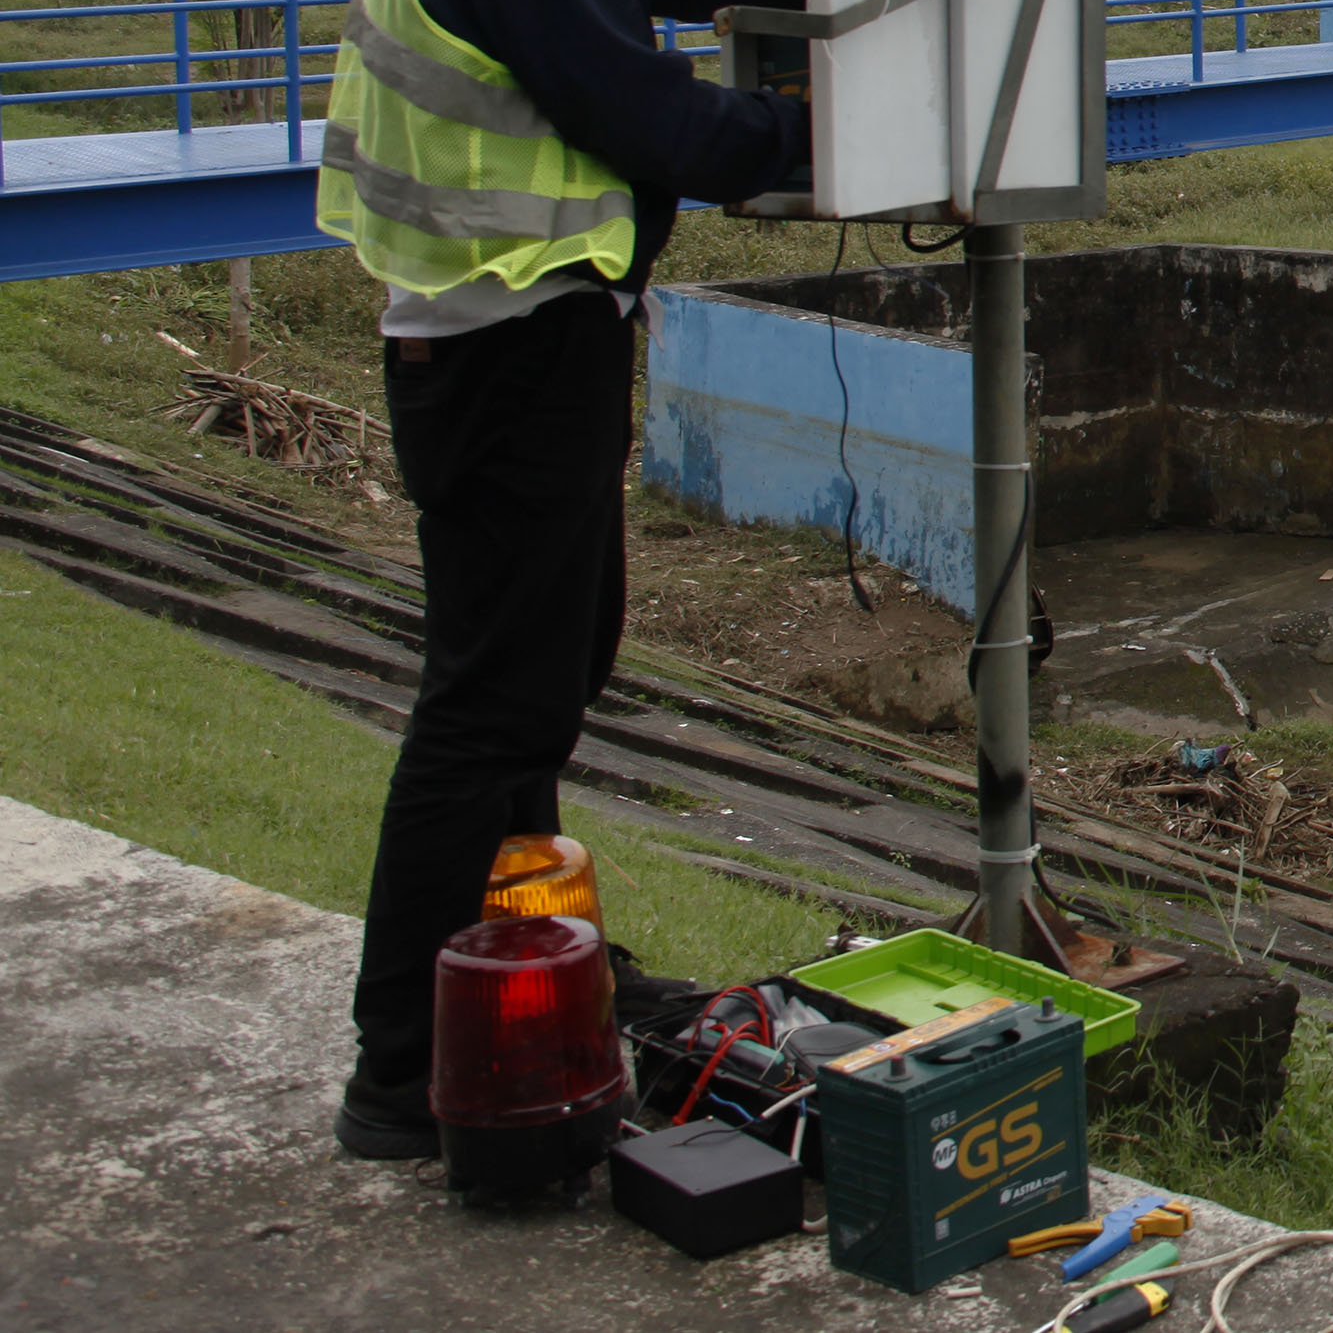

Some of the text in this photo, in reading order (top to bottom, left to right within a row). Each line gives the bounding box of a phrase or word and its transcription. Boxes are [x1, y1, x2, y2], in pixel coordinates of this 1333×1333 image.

[934, 1143, 957, 1164] MF
[957, 1100, 1043, 1180] GS
[1012, 1178, 1043, 1199] ASTRA
